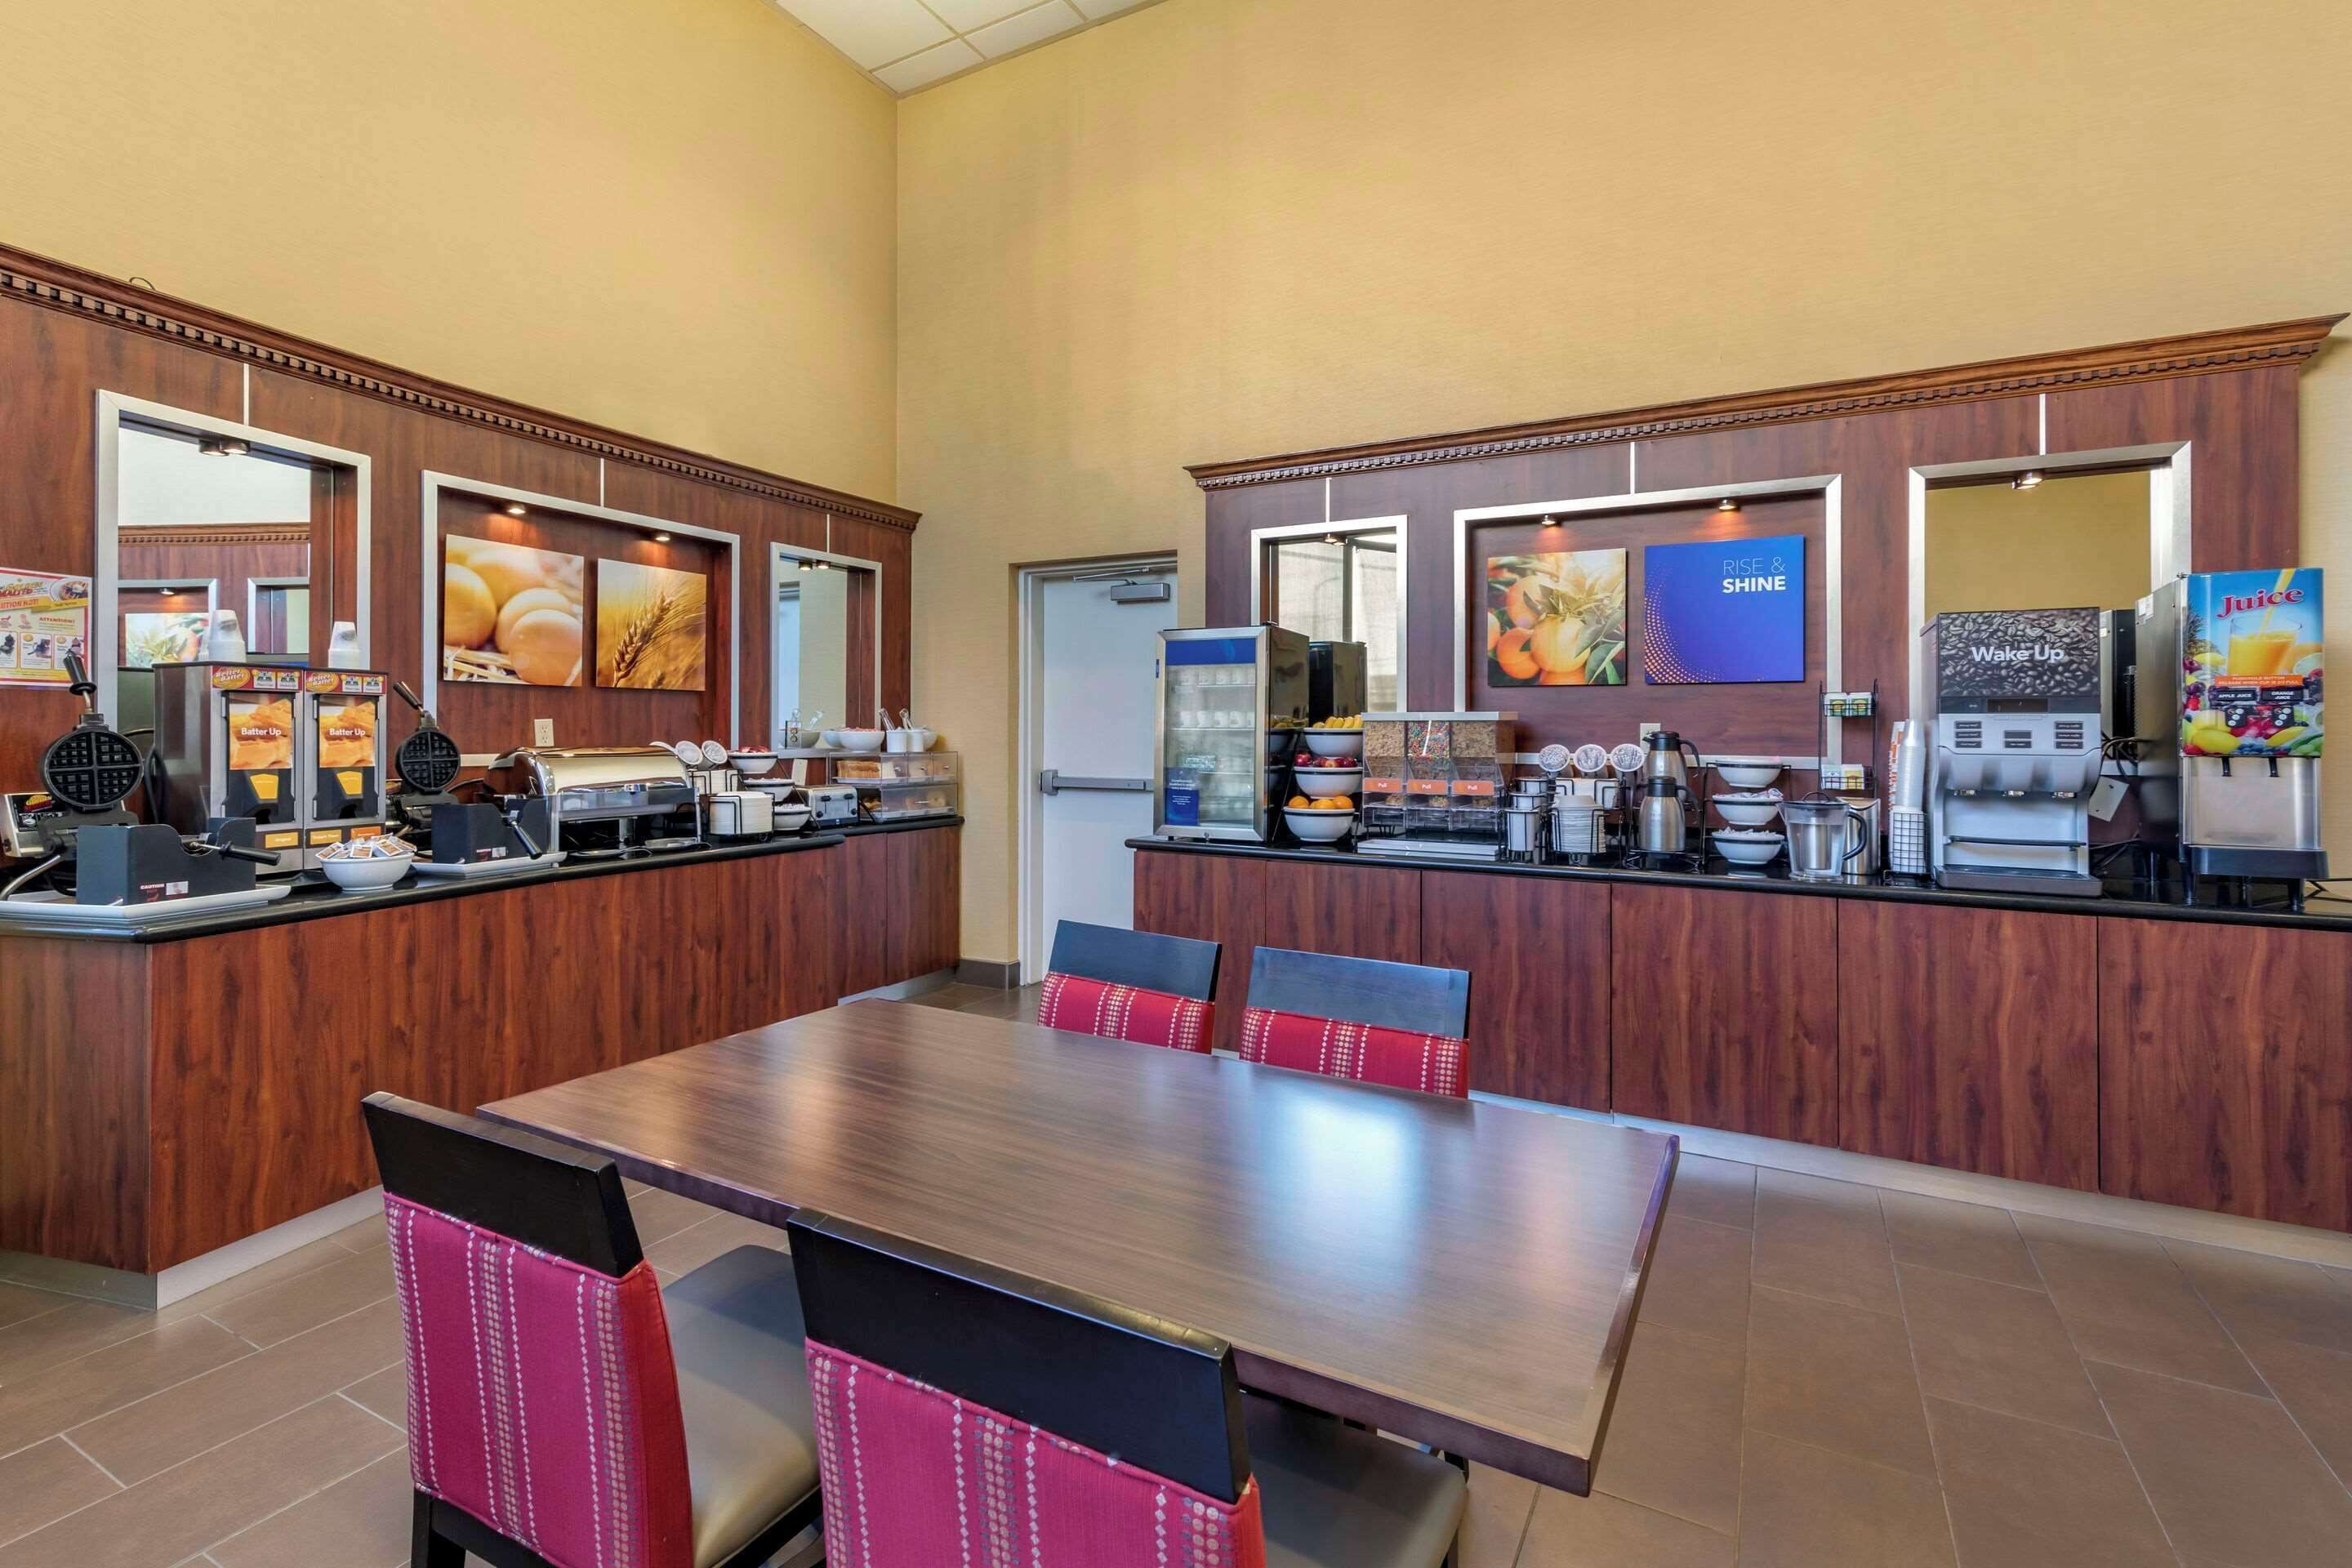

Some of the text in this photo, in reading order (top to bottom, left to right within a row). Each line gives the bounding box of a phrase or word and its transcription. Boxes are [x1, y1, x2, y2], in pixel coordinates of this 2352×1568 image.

[1723, 556, 1786, 576] RISE &
[1722, 575, 1787, 594] SHINE
[2216, 589, 2305, 620] Juice
[1971, 644, 2065, 663] Wake Up
[241, 727, 282, 737] Batter Up
[329, 728, 366, 737] Batter Up
